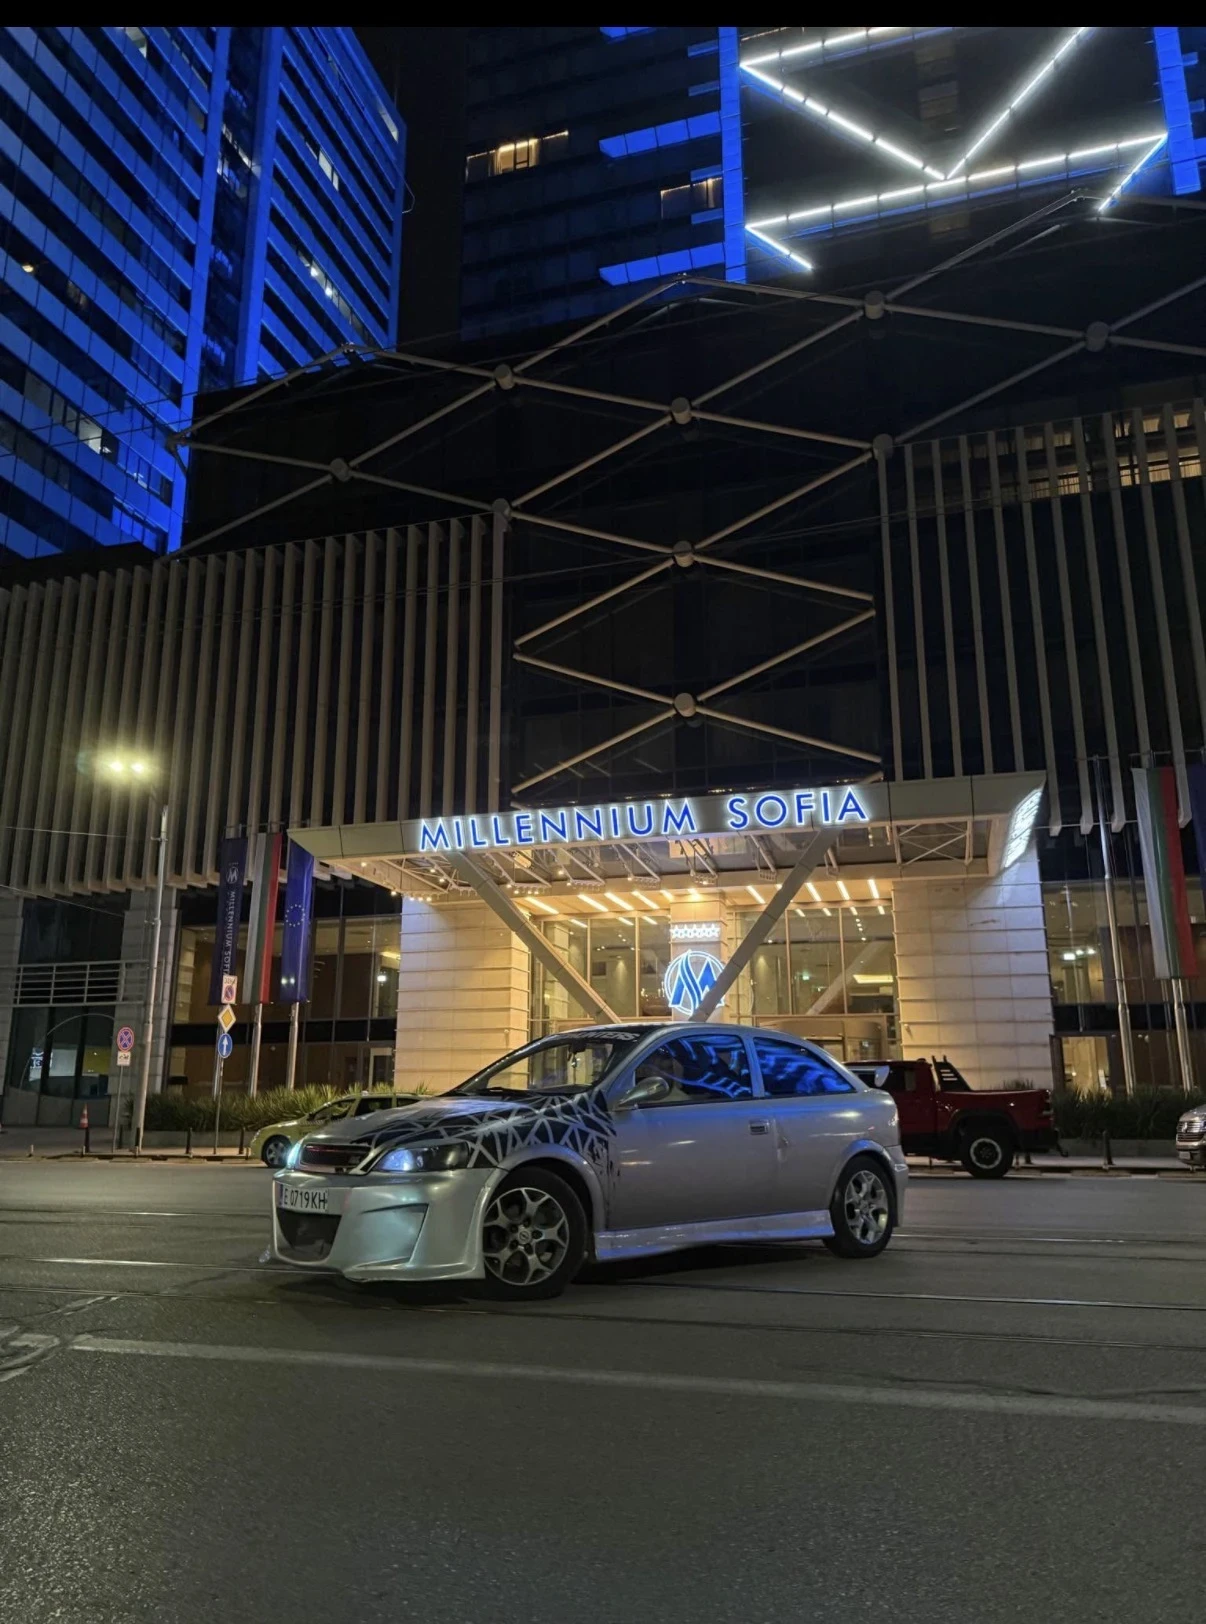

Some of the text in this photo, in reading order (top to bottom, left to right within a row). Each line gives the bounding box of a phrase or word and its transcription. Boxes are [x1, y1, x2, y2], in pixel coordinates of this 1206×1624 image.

[419, 785, 869, 852] MILLENNIUM SOFIA
[225, 890, 236, 948] MILLENNIUM
